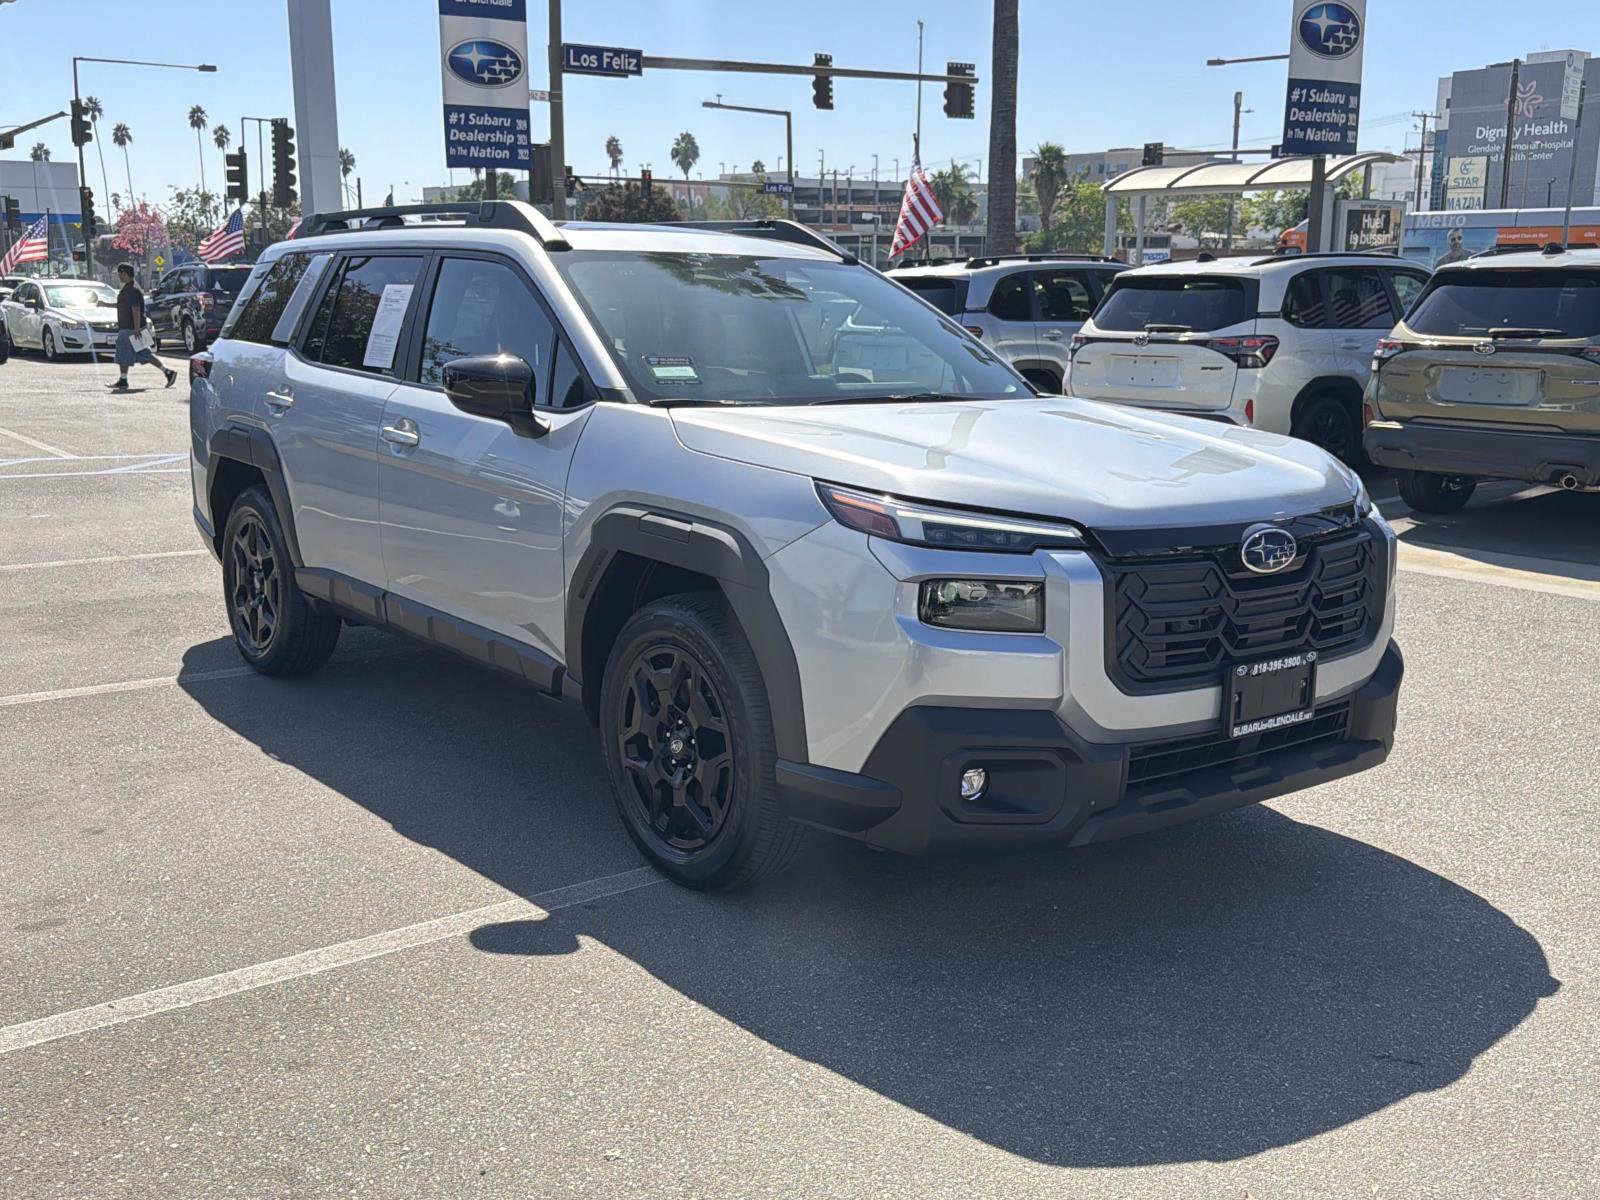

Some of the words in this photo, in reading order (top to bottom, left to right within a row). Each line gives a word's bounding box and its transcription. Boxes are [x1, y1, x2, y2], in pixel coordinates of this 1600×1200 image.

[569, 49, 598, 68] Los
[603, 52, 637, 71] Feliz
[1290, 87, 1307, 103] #1
[1308, 88, 1346, 104] Subaru
[448, 112, 466, 125] #1
[468, 113, 511, 127] Subaru
[1289, 107, 1347, 127] Dealership
[449, 129, 514, 146] Dealership
[1287, 128, 1294, 139] In
[1294, 128, 1305, 139] The
[1305, 127, 1341, 142] Nation
[1475, 125, 1522, 142] Digniy
[1524, 120, 1568, 136] Health
[449, 146, 457, 156] In
[457, 146, 468, 156] The
[469, 146, 510, 159] Nation
[1467, 145, 1501, 154] Glendale
[1540, 139, 1574, 151] Hospital
[765, 184, 777, 193] Los
[778, 184, 793, 193] Feliz
[1453, 177, 1479, 186] STAR
[1447, 196, 1482, 209] MAZDA
[1415, 215, 1467, 228] Metro
